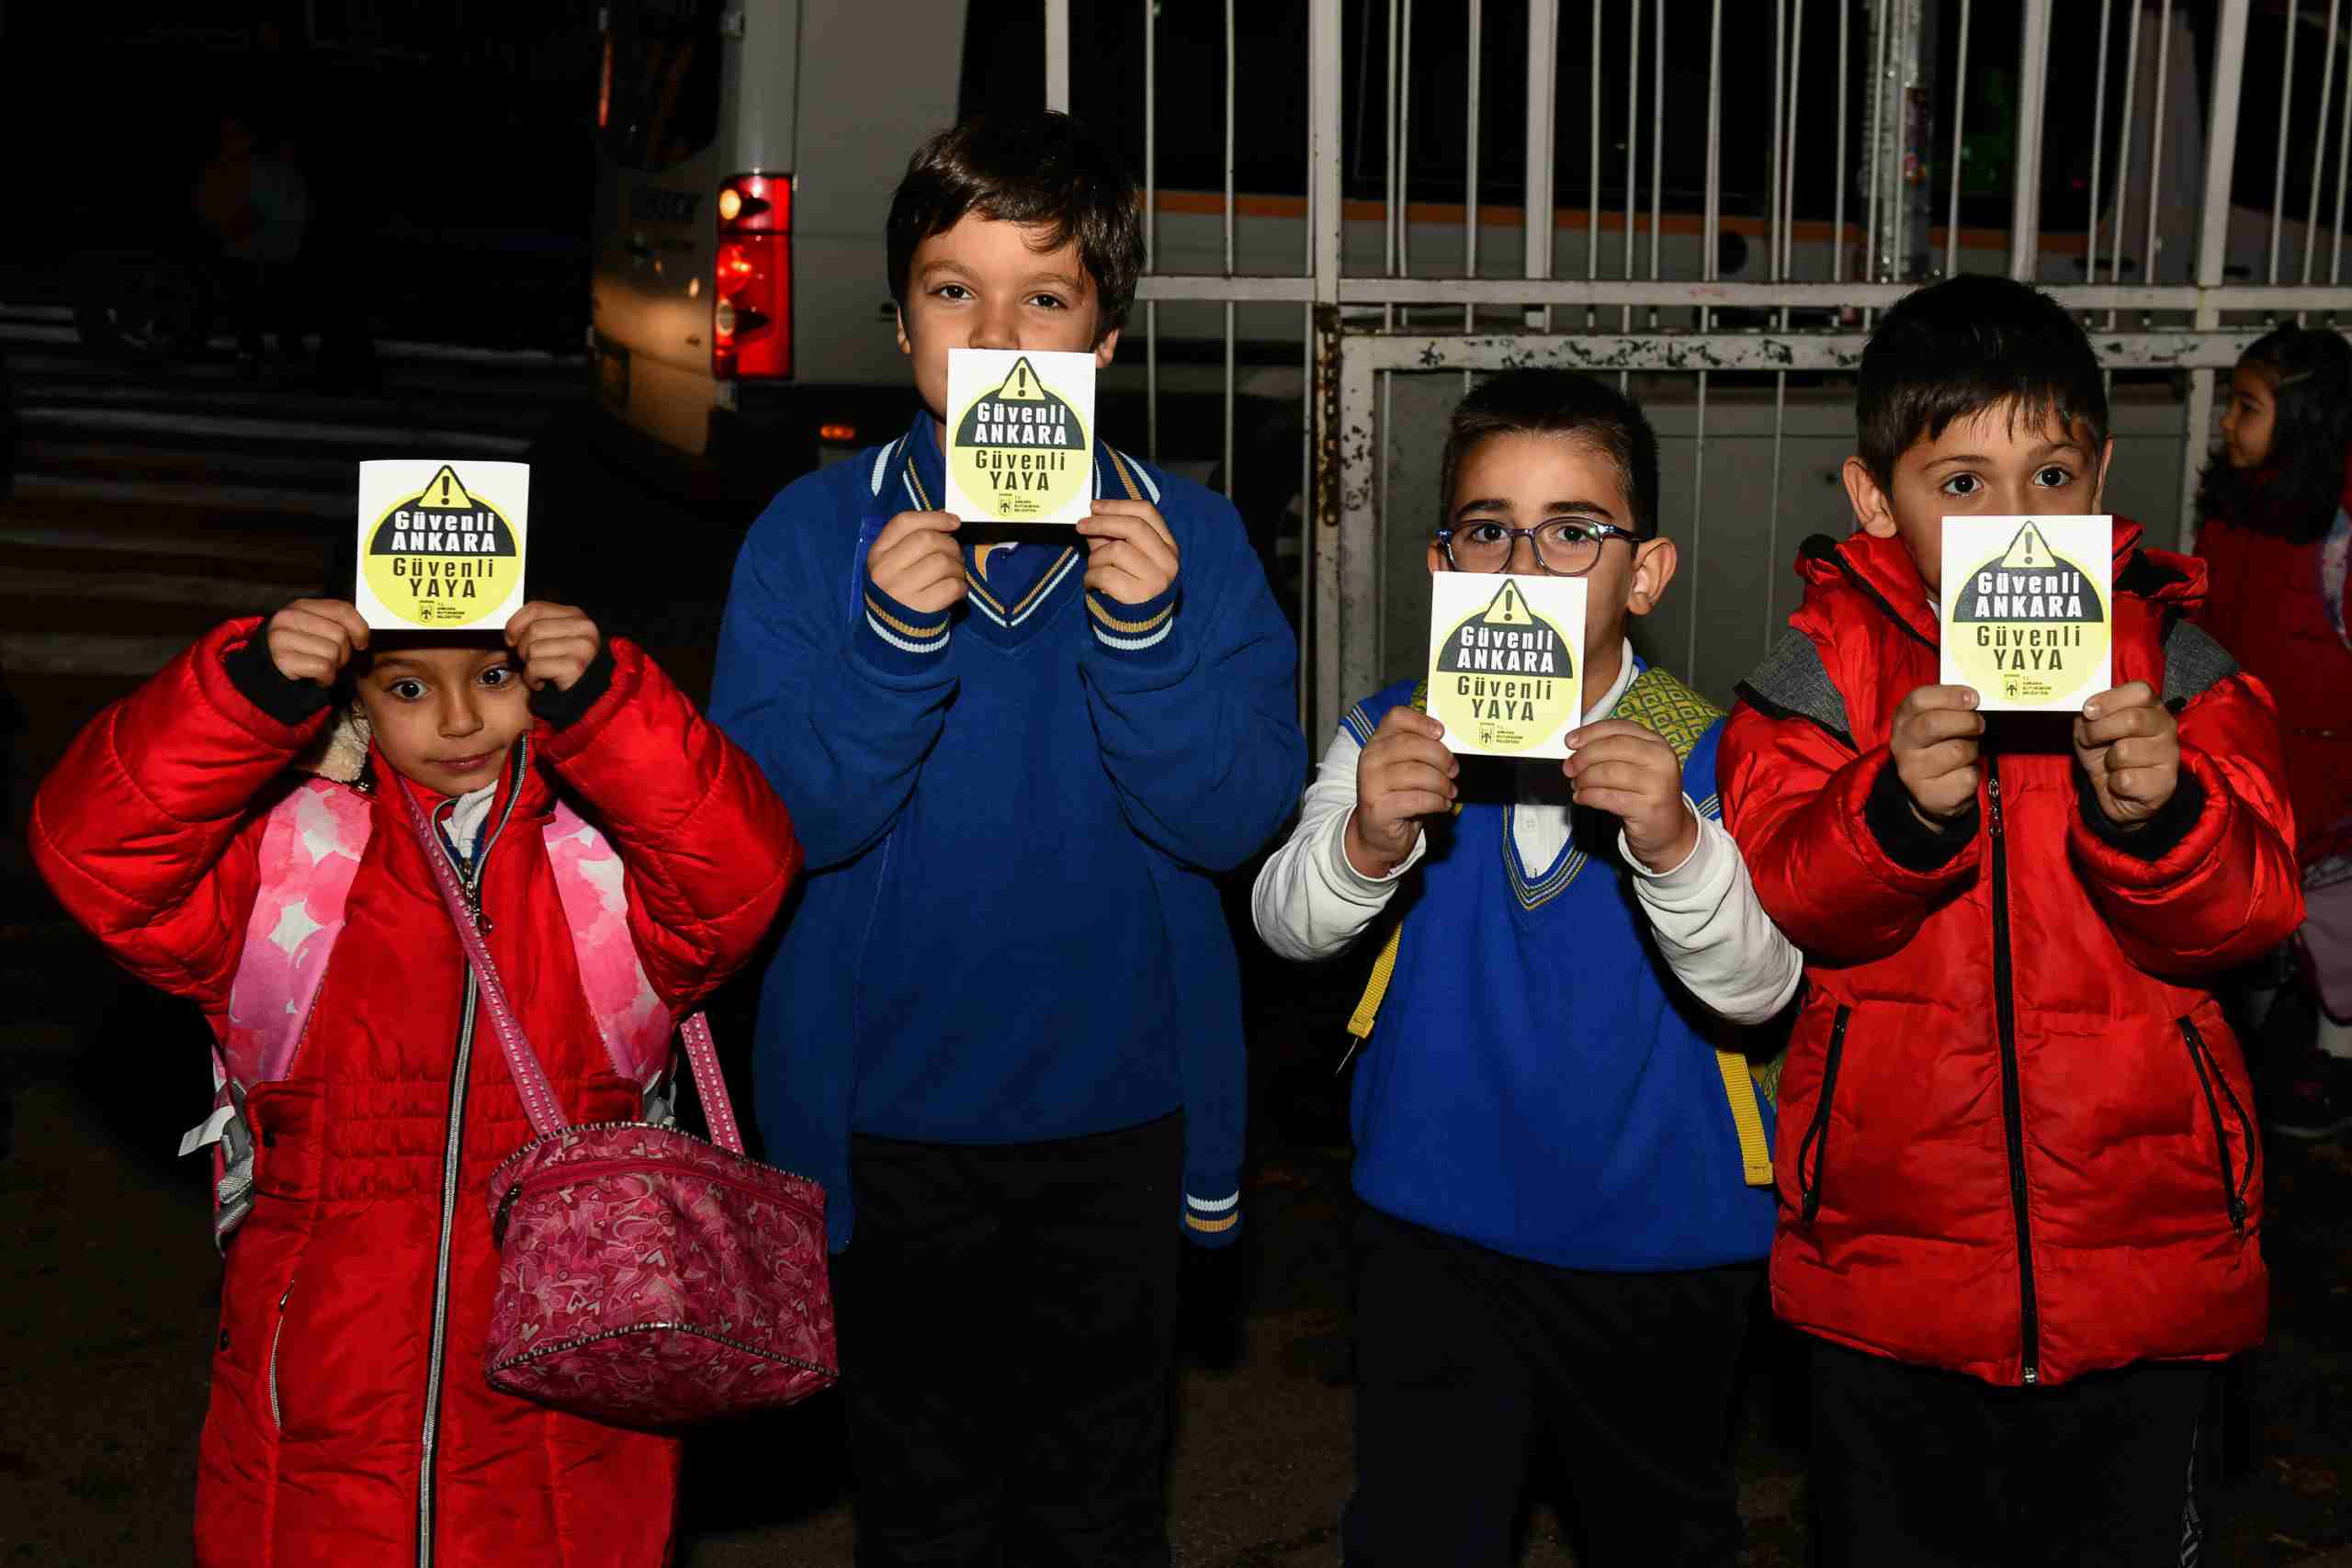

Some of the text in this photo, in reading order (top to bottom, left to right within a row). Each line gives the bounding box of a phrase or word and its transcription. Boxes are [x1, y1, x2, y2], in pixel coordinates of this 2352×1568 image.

[977, 402, 1066, 424] Güvenli
[974, 423, 1067, 446] ANKARA
[975, 450, 1066, 470] Güvenli
[989, 471, 1049, 491] YAYA
[394, 511, 495, 532] Güvenli
[390, 531, 496, 552] ANKARA
[392, 557, 494, 578] Güvenli
[409, 578, 476, 598] YAYA
[1977, 571, 2080, 594] Güvenli
[1974, 595, 2083, 618] ANKARA
[1460, 626, 1554, 650] Güvenli
[1976, 626, 2081, 647] Güvenli
[1456, 648, 1555, 673] ANKARA
[1993, 649, 2063, 671] YAYA
[1457, 675, 1552, 700] Güvenli
[1471, 698, 1534, 721] YAYA
